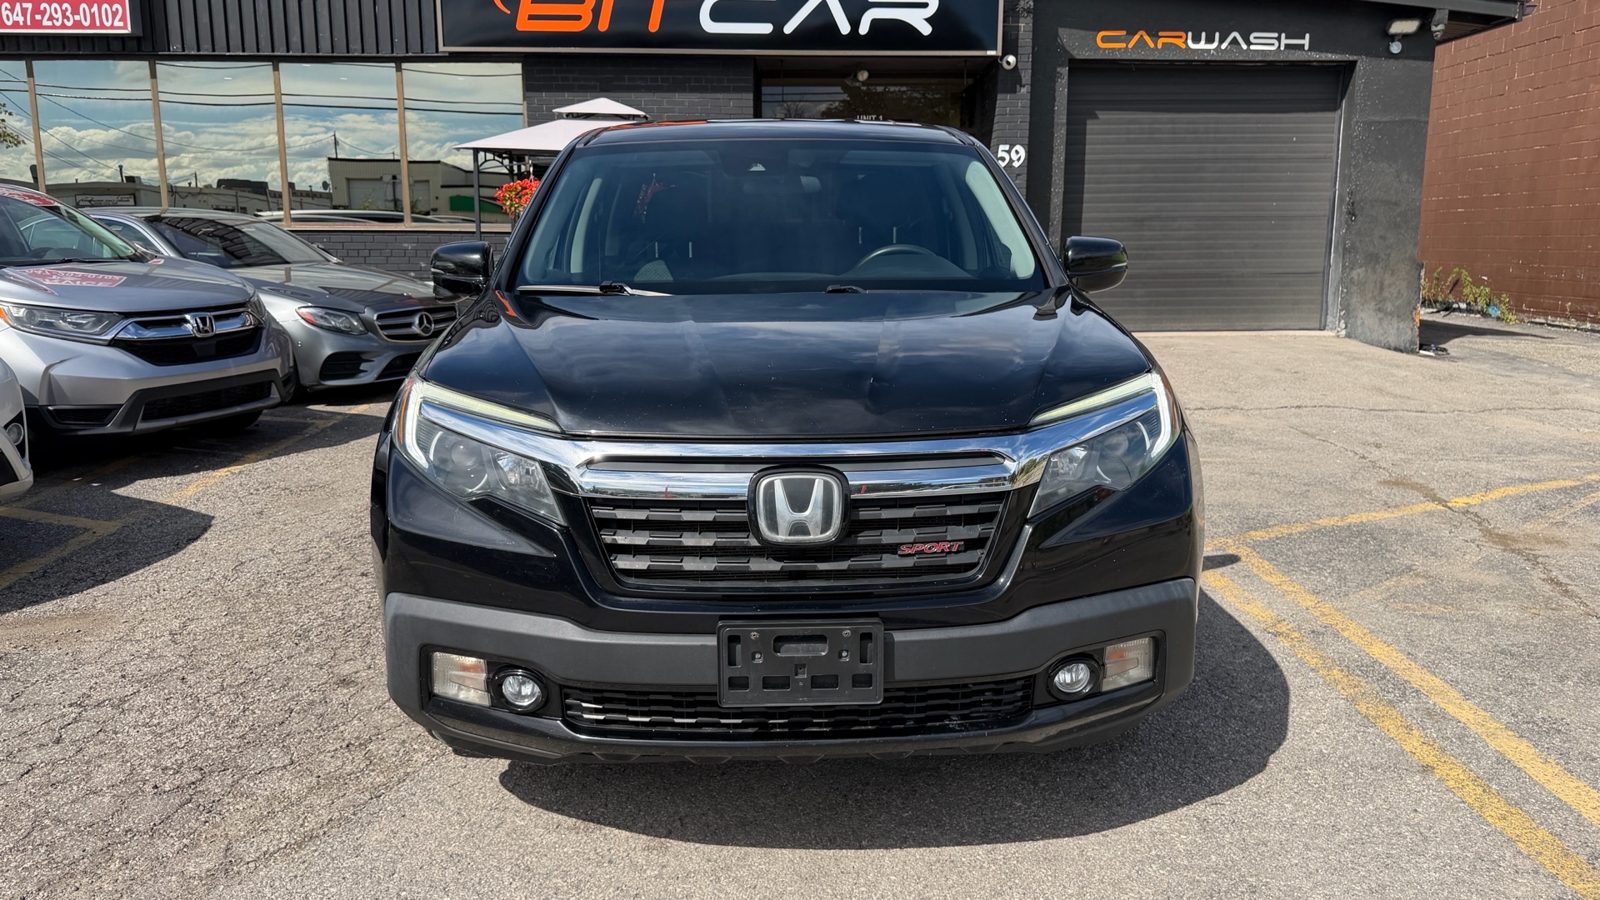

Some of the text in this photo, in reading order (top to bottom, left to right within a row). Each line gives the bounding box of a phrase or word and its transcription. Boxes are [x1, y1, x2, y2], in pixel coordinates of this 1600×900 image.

[1, 2, 124, 27] 647-293-0102
[1096, 30, 1310, 51] CARWASH
[997, 144, 1026, 168] 59
[897, 541, 965, 555] SPORT
